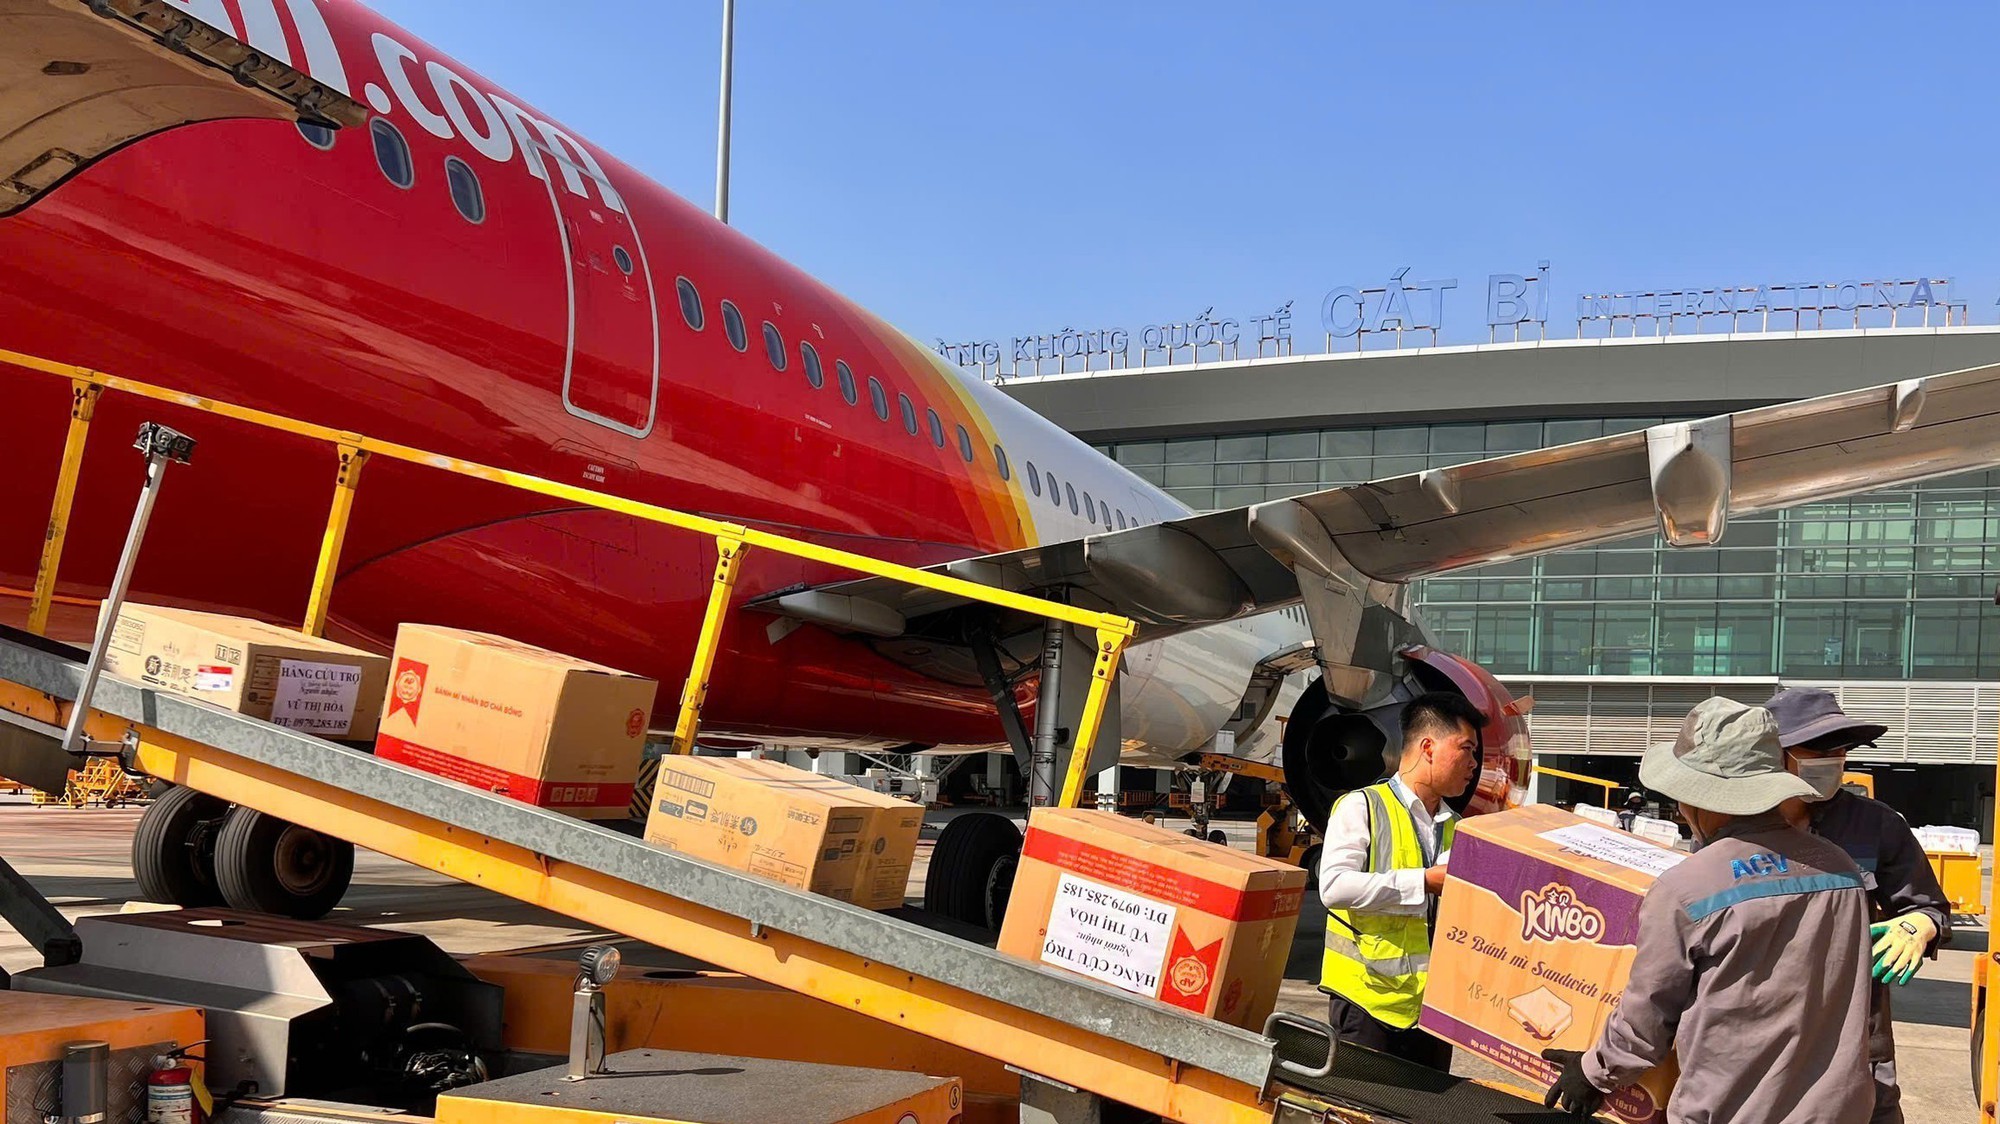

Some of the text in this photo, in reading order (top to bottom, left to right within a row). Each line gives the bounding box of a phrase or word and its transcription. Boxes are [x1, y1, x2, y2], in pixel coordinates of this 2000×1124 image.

[1321, 267, 1458, 338] CÁT
[1576, 277, 1968, 321] INTERNATIONAL
[1012, 327, 1128, 361] KHÔNG
[1140, 306, 1240, 352] QUỐC
[1250, 300, 1293, 341] TẾ
[281, 665, 360, 684] HÀNG CỨU TRỢ
[434, 687, 452, 697] BÁNH
[288, 699, 344, 714] VŨ THỊ HÒA
[293, 718, 348, 729] 0979.285.185
[1730, 853, 1788, 879] ACV
[1063, 882, 1140, 917] 0979.285.185
[1070, 907, 1149, 944] VŨ THỊ HÒA
[1524, 896, 1599, 938] KINBO
[1043, 940, 1074, 961] TRỢ
[1076, 931, 1133, 958] Người nhận:
[1077, 952, 1110, 972] CỨU
[1446, 926, 1468, 944] 32
[1471, 935, 1508, 961] Bánh
[1509, 955, 1528, 970] mì
[1531, 961, 1598, 998] Sandwich
[1112, 963, 1156, 988] HÀNG
